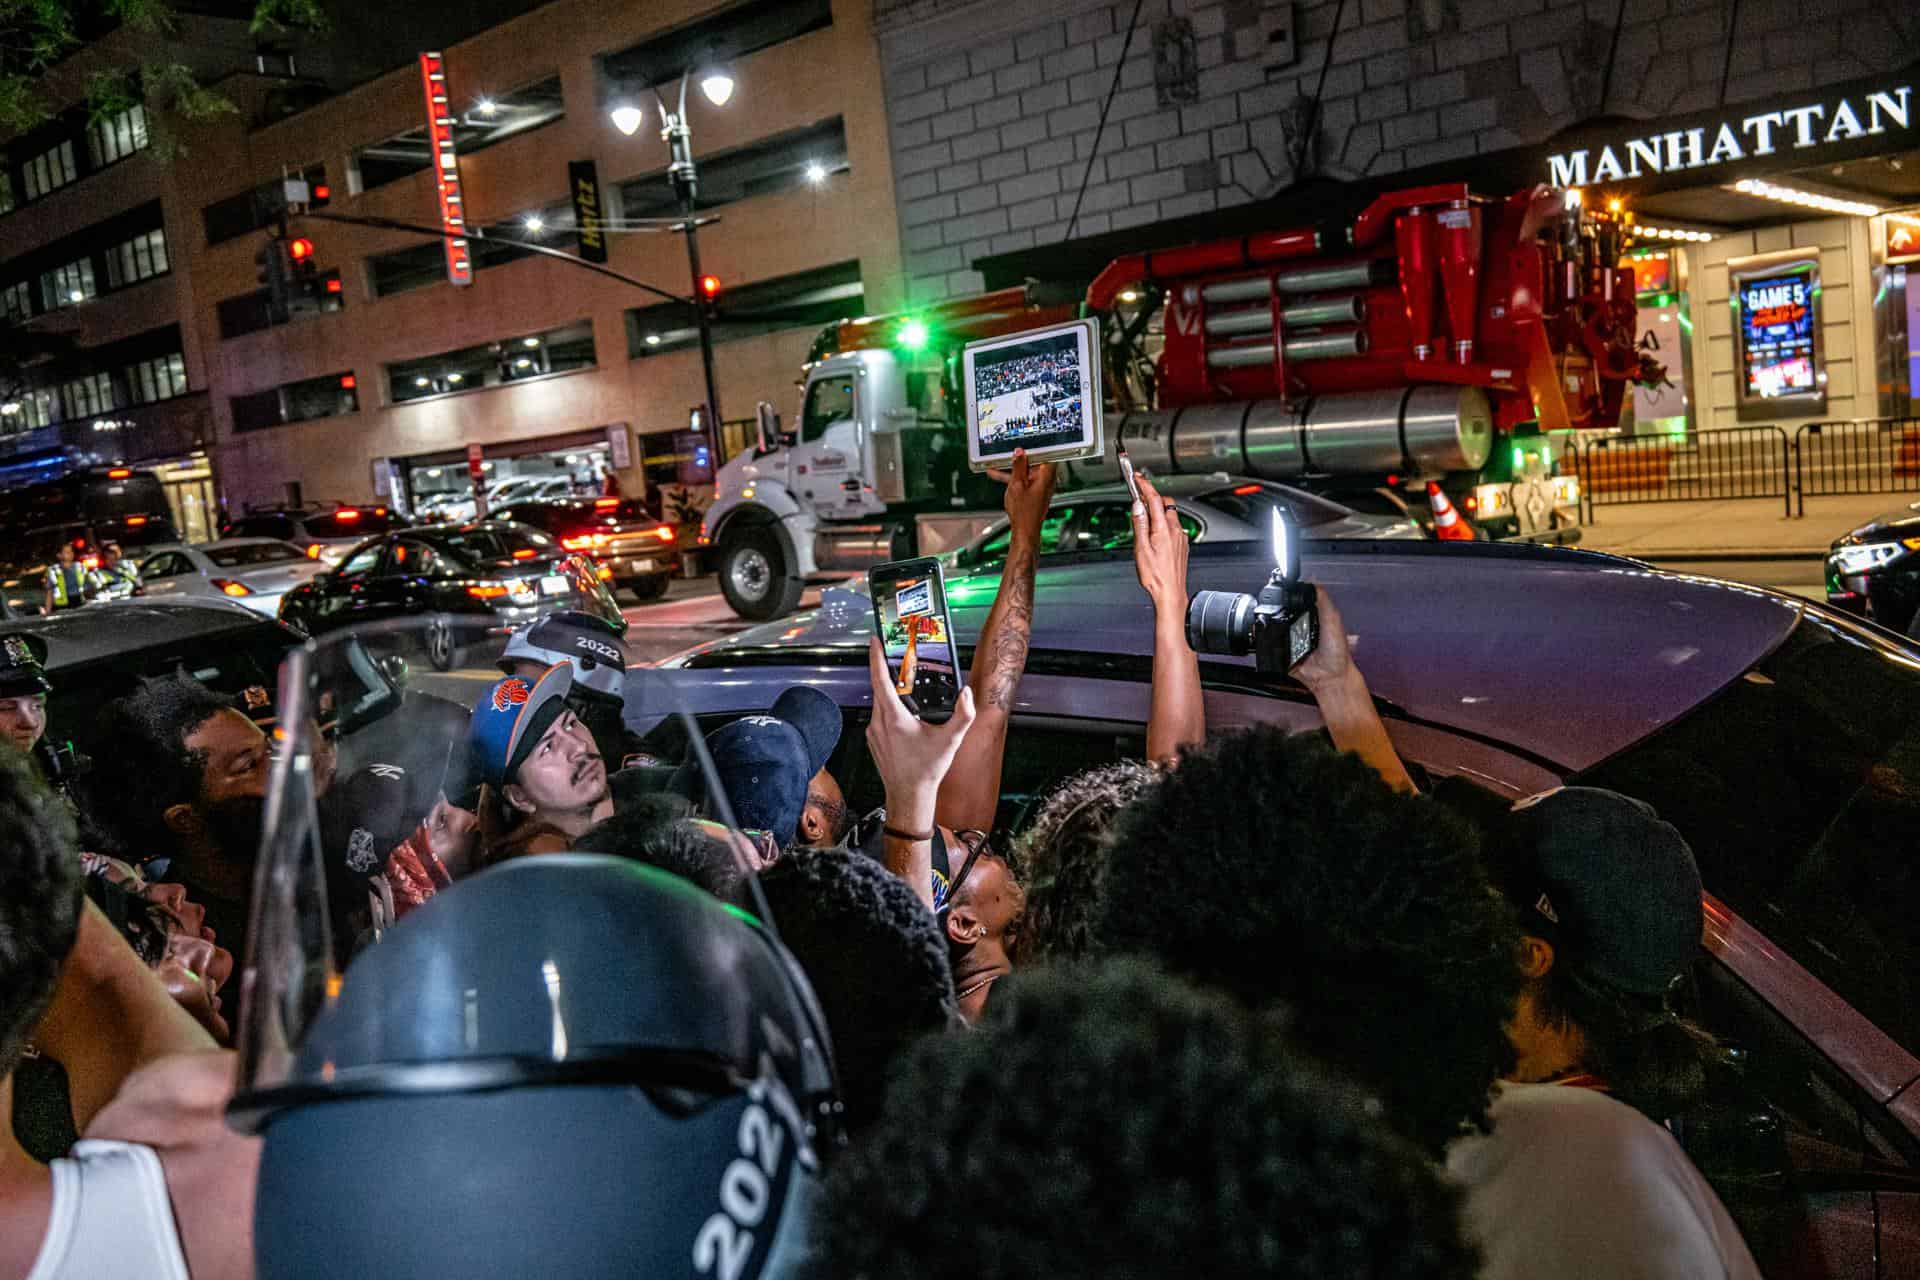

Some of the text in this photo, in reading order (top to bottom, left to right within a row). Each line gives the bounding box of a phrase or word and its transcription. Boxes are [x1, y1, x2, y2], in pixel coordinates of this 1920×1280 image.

[1547, 84, 1913, 191] MANHATTAN
[1748, 283, 1805, 311] GAME 5
[693, 1084, 785, 1280] 202
